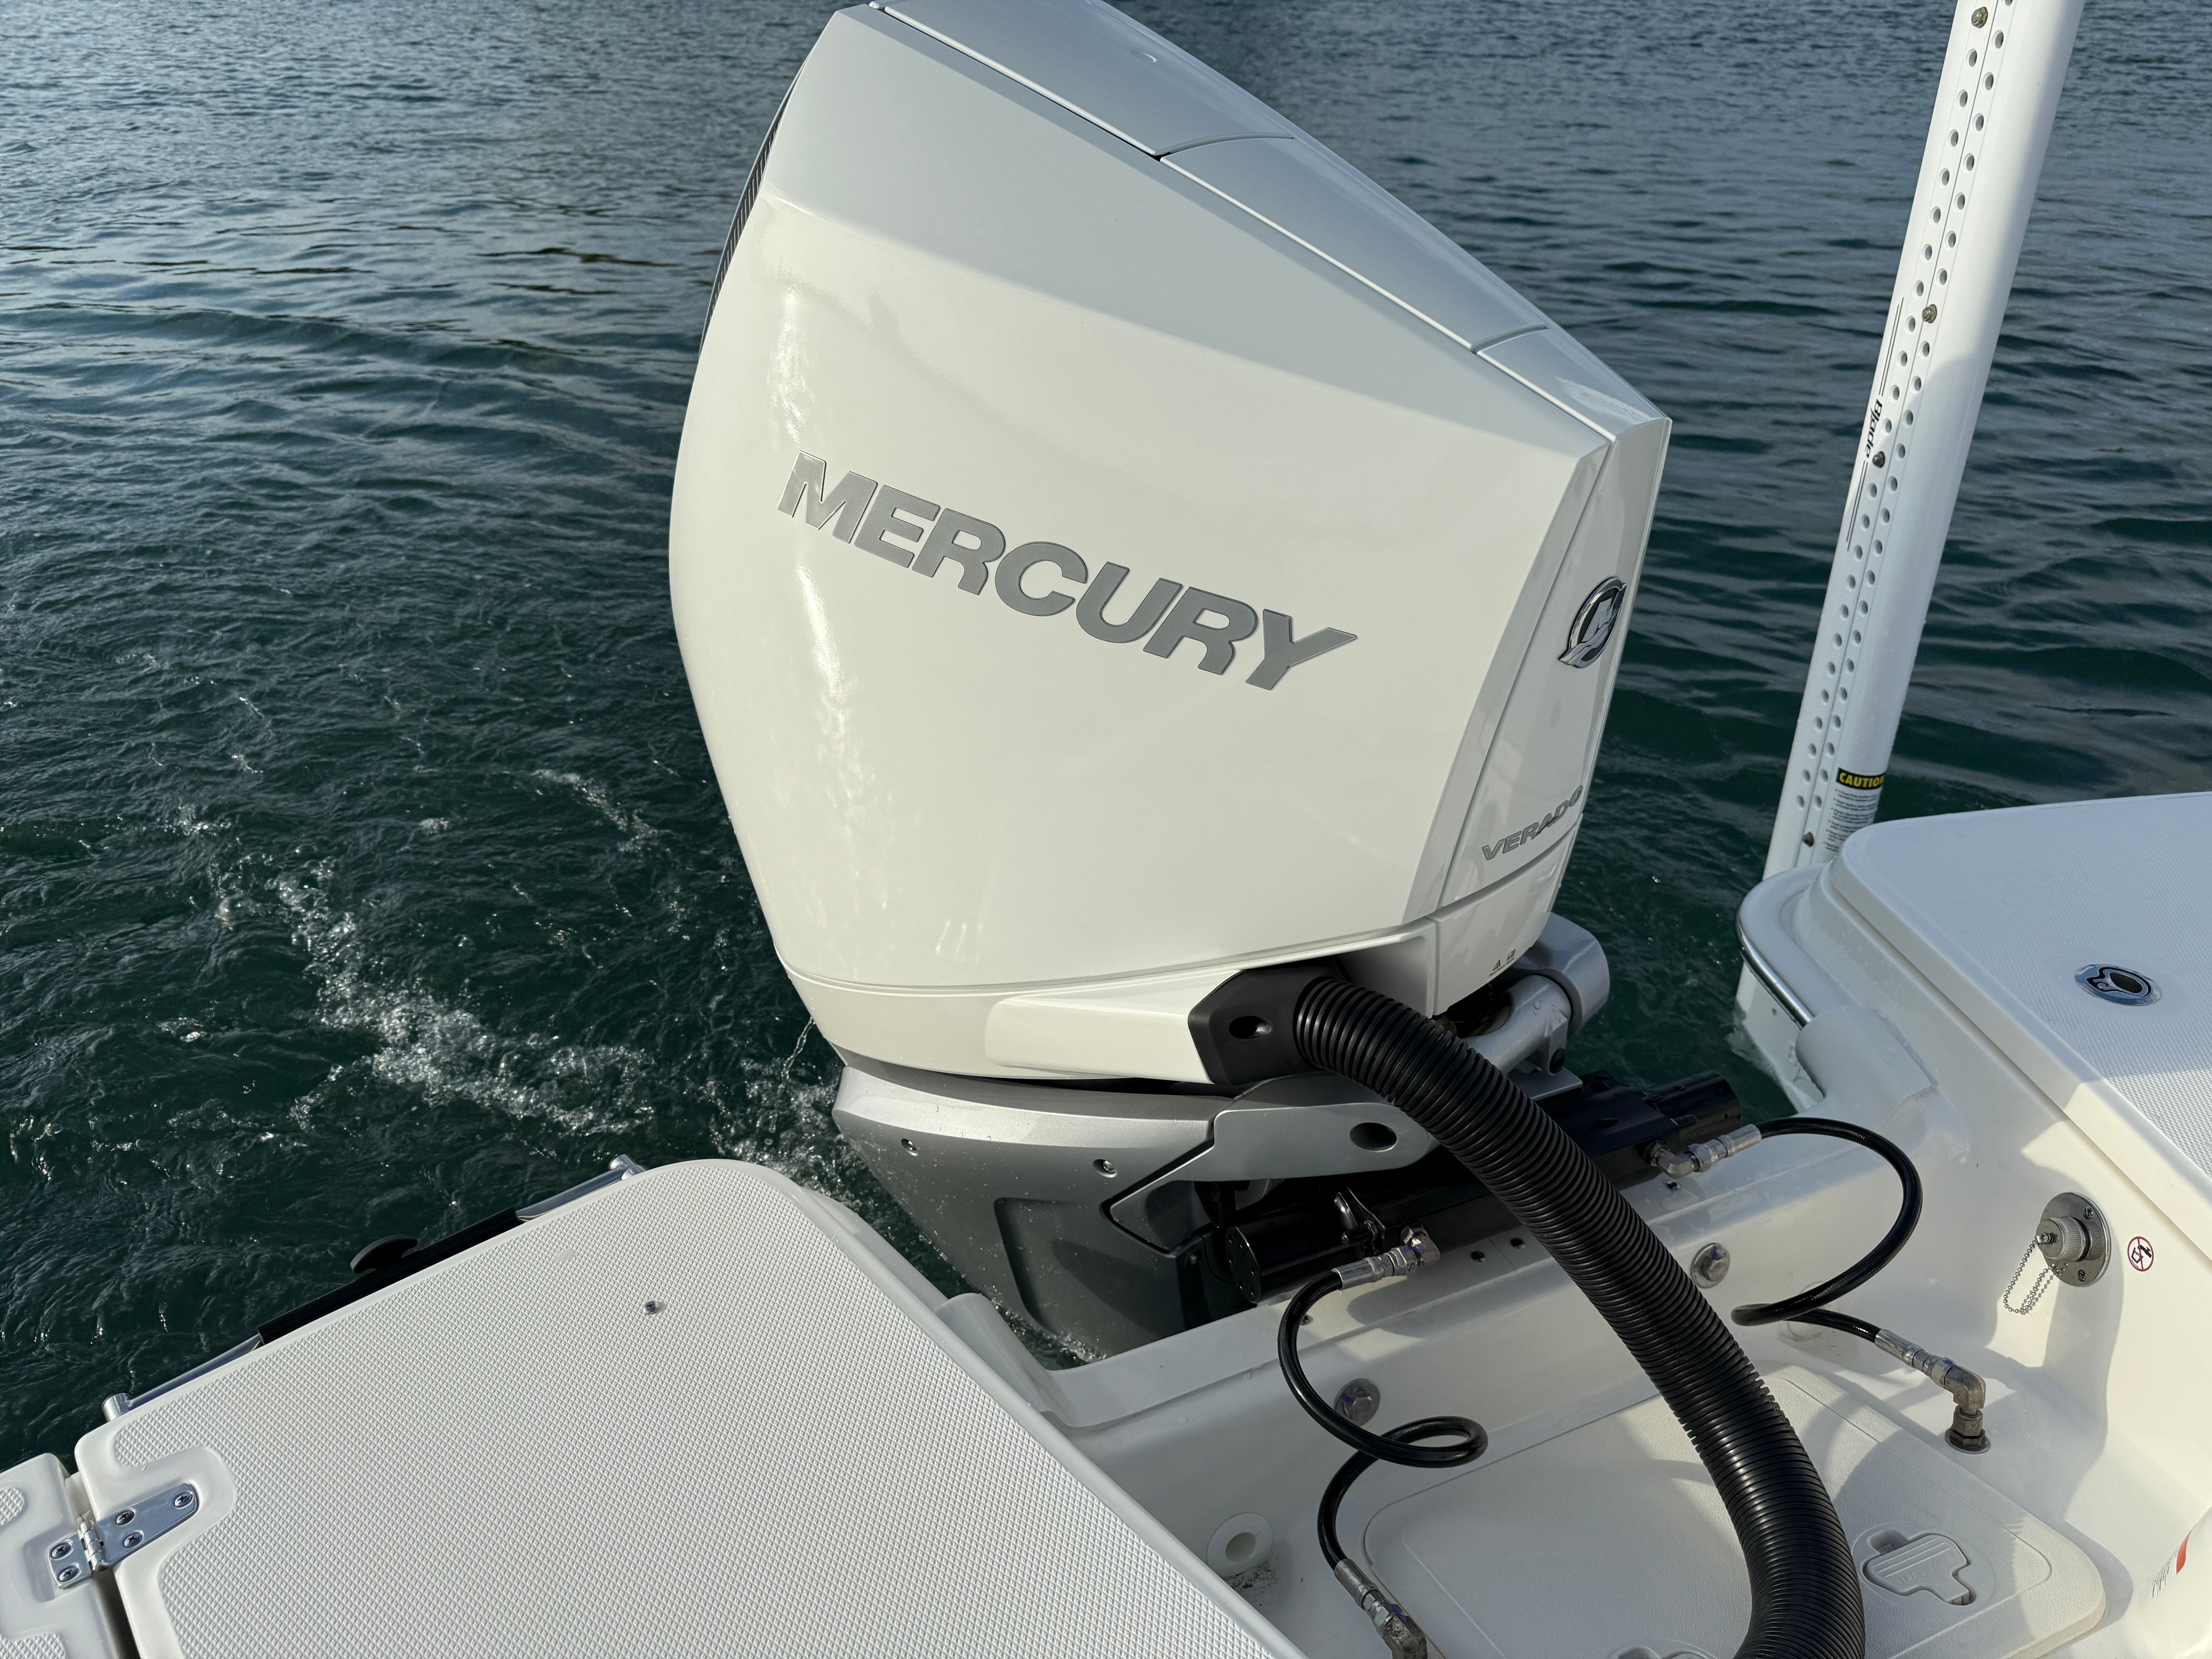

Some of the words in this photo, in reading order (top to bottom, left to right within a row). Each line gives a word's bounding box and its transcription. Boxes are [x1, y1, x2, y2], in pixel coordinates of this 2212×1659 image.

[1865, 399, 1882, 458] Blade
[778, 451, 1357, 690] MERCURY
[1839, 773, 1884, 787] CAUTION
[1482, 785, 1583, 860] VERADO
